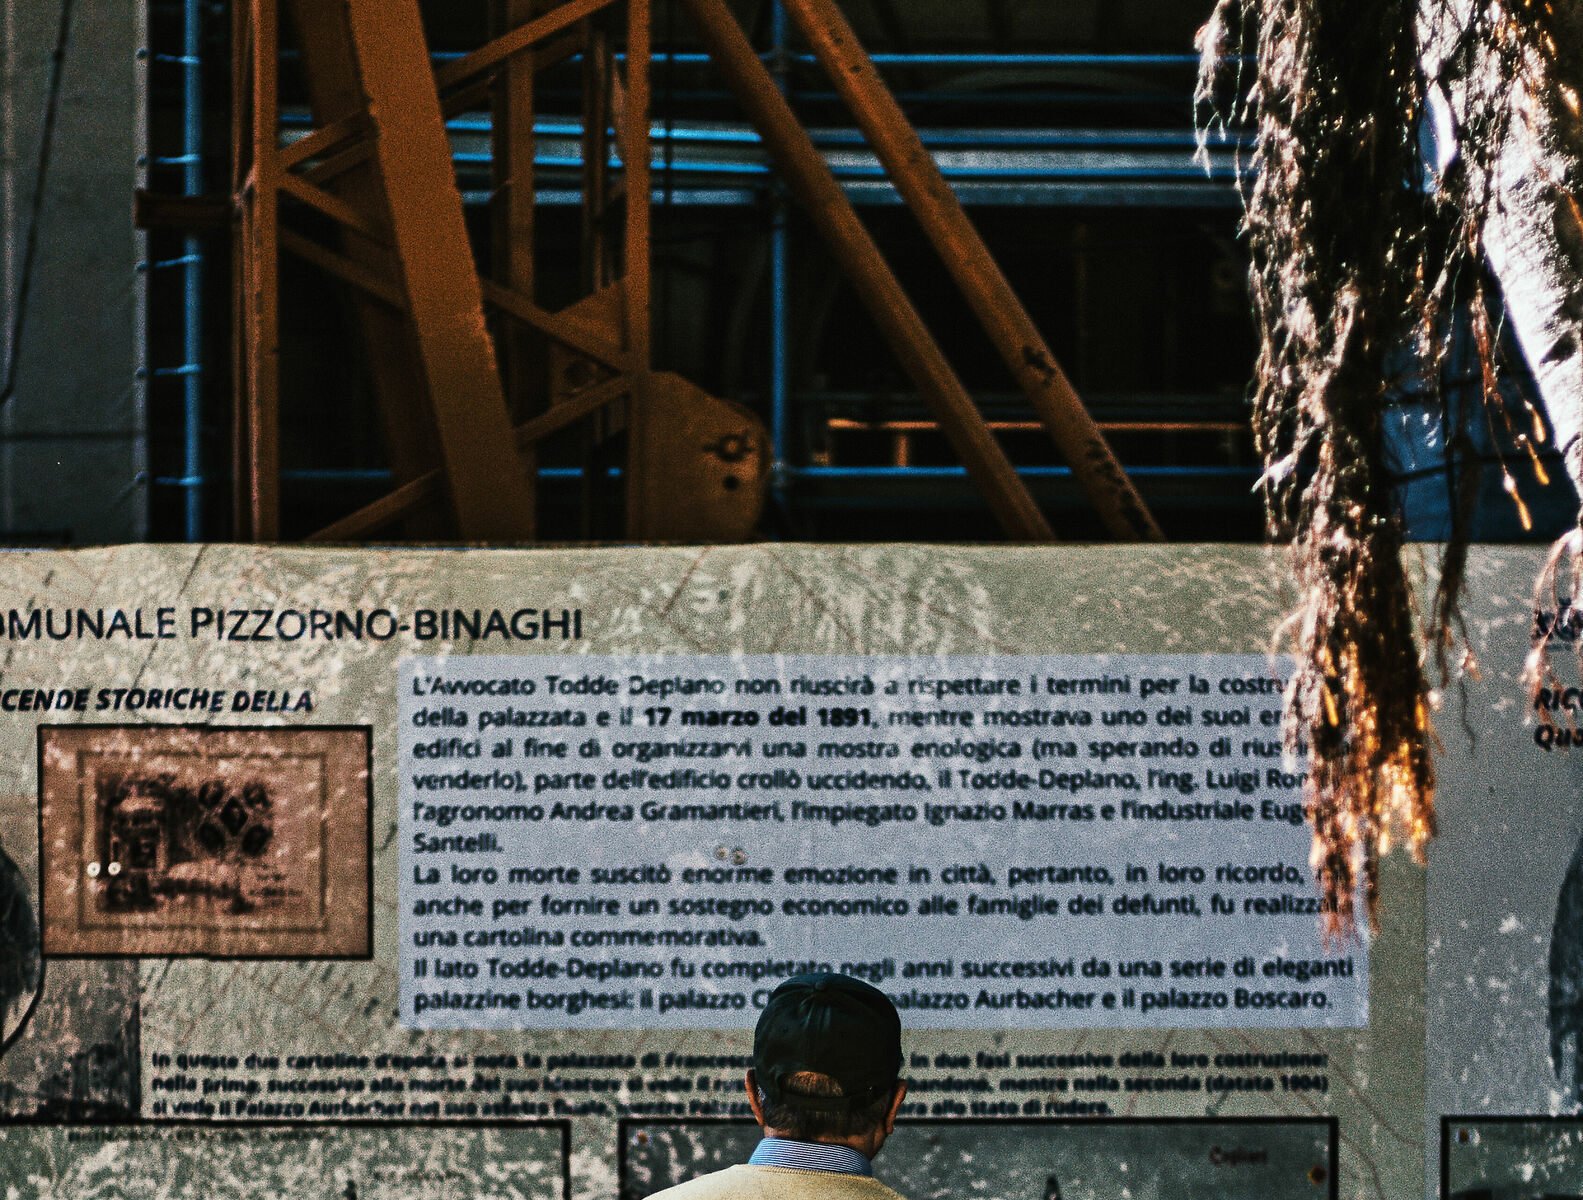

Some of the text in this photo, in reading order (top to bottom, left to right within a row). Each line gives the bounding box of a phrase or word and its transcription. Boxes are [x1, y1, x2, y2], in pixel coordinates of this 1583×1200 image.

[0, 607, 582, 641] MUNALE PIZZORNO-BINAGHI
[0, 687, 313, 713] CENDE STORICHE DELLA
[413, 675, 536, 697] L'Avvocato
[545, 675, 619, 696] Todde
[629, 675, 725, 700] Deplano
[735, 679, 781, 696] non
[791, 674, 875, 696] riuscirà
[884, 681, 899, 696] a
[908, 677, 1020, 700] rispettare
[1030, 675, 1038, 695] i
[1047, 675, 1131, 696] termini
[1140, 678, 1180, 700] per
[1189, 674, 1210, 695] la
[413, 707, 468, 728] della
[478, 707, 587, 732] palazzata
[596, 711, 611, 728] e
[620, 707, 633, 727] il
[644, 707, 672, 727] 17
[681, 710, 760, 727] marzo
[768, 706, 807, 727] del
[816, 707, 879, 730] 1891,
[888, 709, 974, 728] mentre
[984, 709, 1092, 728] mostrava
[1102, 710, 1147, 728] uno
[1156, 706, 1192, 727] dei
[1202, 706, 1250, 727] suoi
[413, 737, 481, 759] edifici
[492, 739, 512, 758] al
[524, 737, 568, 758] fine
[579, 737, 601, 758] di
[612, 738, 751, 763] organizzarvi
[763, 742, 807, 758] una
[817, 741, 899, 758] mostra
[910, 737, 1022, 764] enologica
[1032, 737, 1077, 761] (ma
[1088, 737, 1199, 762] sperando
[1209, 737, 1231, 758] di
[534, 772, 596, 794] parte
[602, 769, 731, 790] dell'edificio
[737, 769, 802, 790] crollò
[807, 770, 931, 792] uccidendo,
[938, 769, 952, 789] il
[1206, 768, 1260, 795] Luigi
[413, 802, 544, 828] l'agronomo
[550, 801, 634, 822] Andrea
[640, 801, 785, 822] Gramantieri,
[792, 801, 917, 827] l'impiegato
[924, 802, 1007, 827] Ignazio
[1013, 801, 1095, 822] Marras
[1101, 804, 1115, 821] e
[1121, 800, 1254, 821] l'industriale
[413, 832, 503, 853] Santelli.
[414, 862, 1305, 888] La loro morte suscitò enorme emozione in città, pertanto, in loro ricordo,
[413, 893, 1324, 921] anche per fornire un sostegno economico alle famiglie dei defunti, fu realizz
[414, 927, 766, 948] una cartolina commemorativa.
[414, 958, 427, 978] Il
[435, 958, 479, 979] lato
[487, 958, 664, 982] Todde-Deplano
[670, 957, 695, 978] fu
[840, 957, 895, 982] negli
[902, 958, 953, 978] anni
[961, 958, 1074, 978] successivi
[1082, 957, 1111, 978] da
[1118, 961, 1162, 978] una
[1170, 958, 1226, 978] serie
[1233, 956, 1255, 978] di
[1262, 956, 1353, 983] eleganti
[414, 990, 521, 1015] palazzine
[527, 989, 633, 1015] borghesi:
[640, 989, 653, 1009] il
[659, 989, 746, 1014] palazzo
[975, 989, 1096, 1010] Aurbacher
[1102, 992, 1116, 1009] e
[1123, 988, 1135, 1009] il
[1141, 988, 1228, 1013] palazzo
[1234, 988, 1333, 1010] Boscaro.
[1016, 1052, 1114, 1069] successive
[1171, 1051, 1209, 1068] loro
[999, 1077, 1068, 1093] mentre
[1073, 1075, 1120, 1093] nella
[1124, 1075, 1201, 1093] seconda
